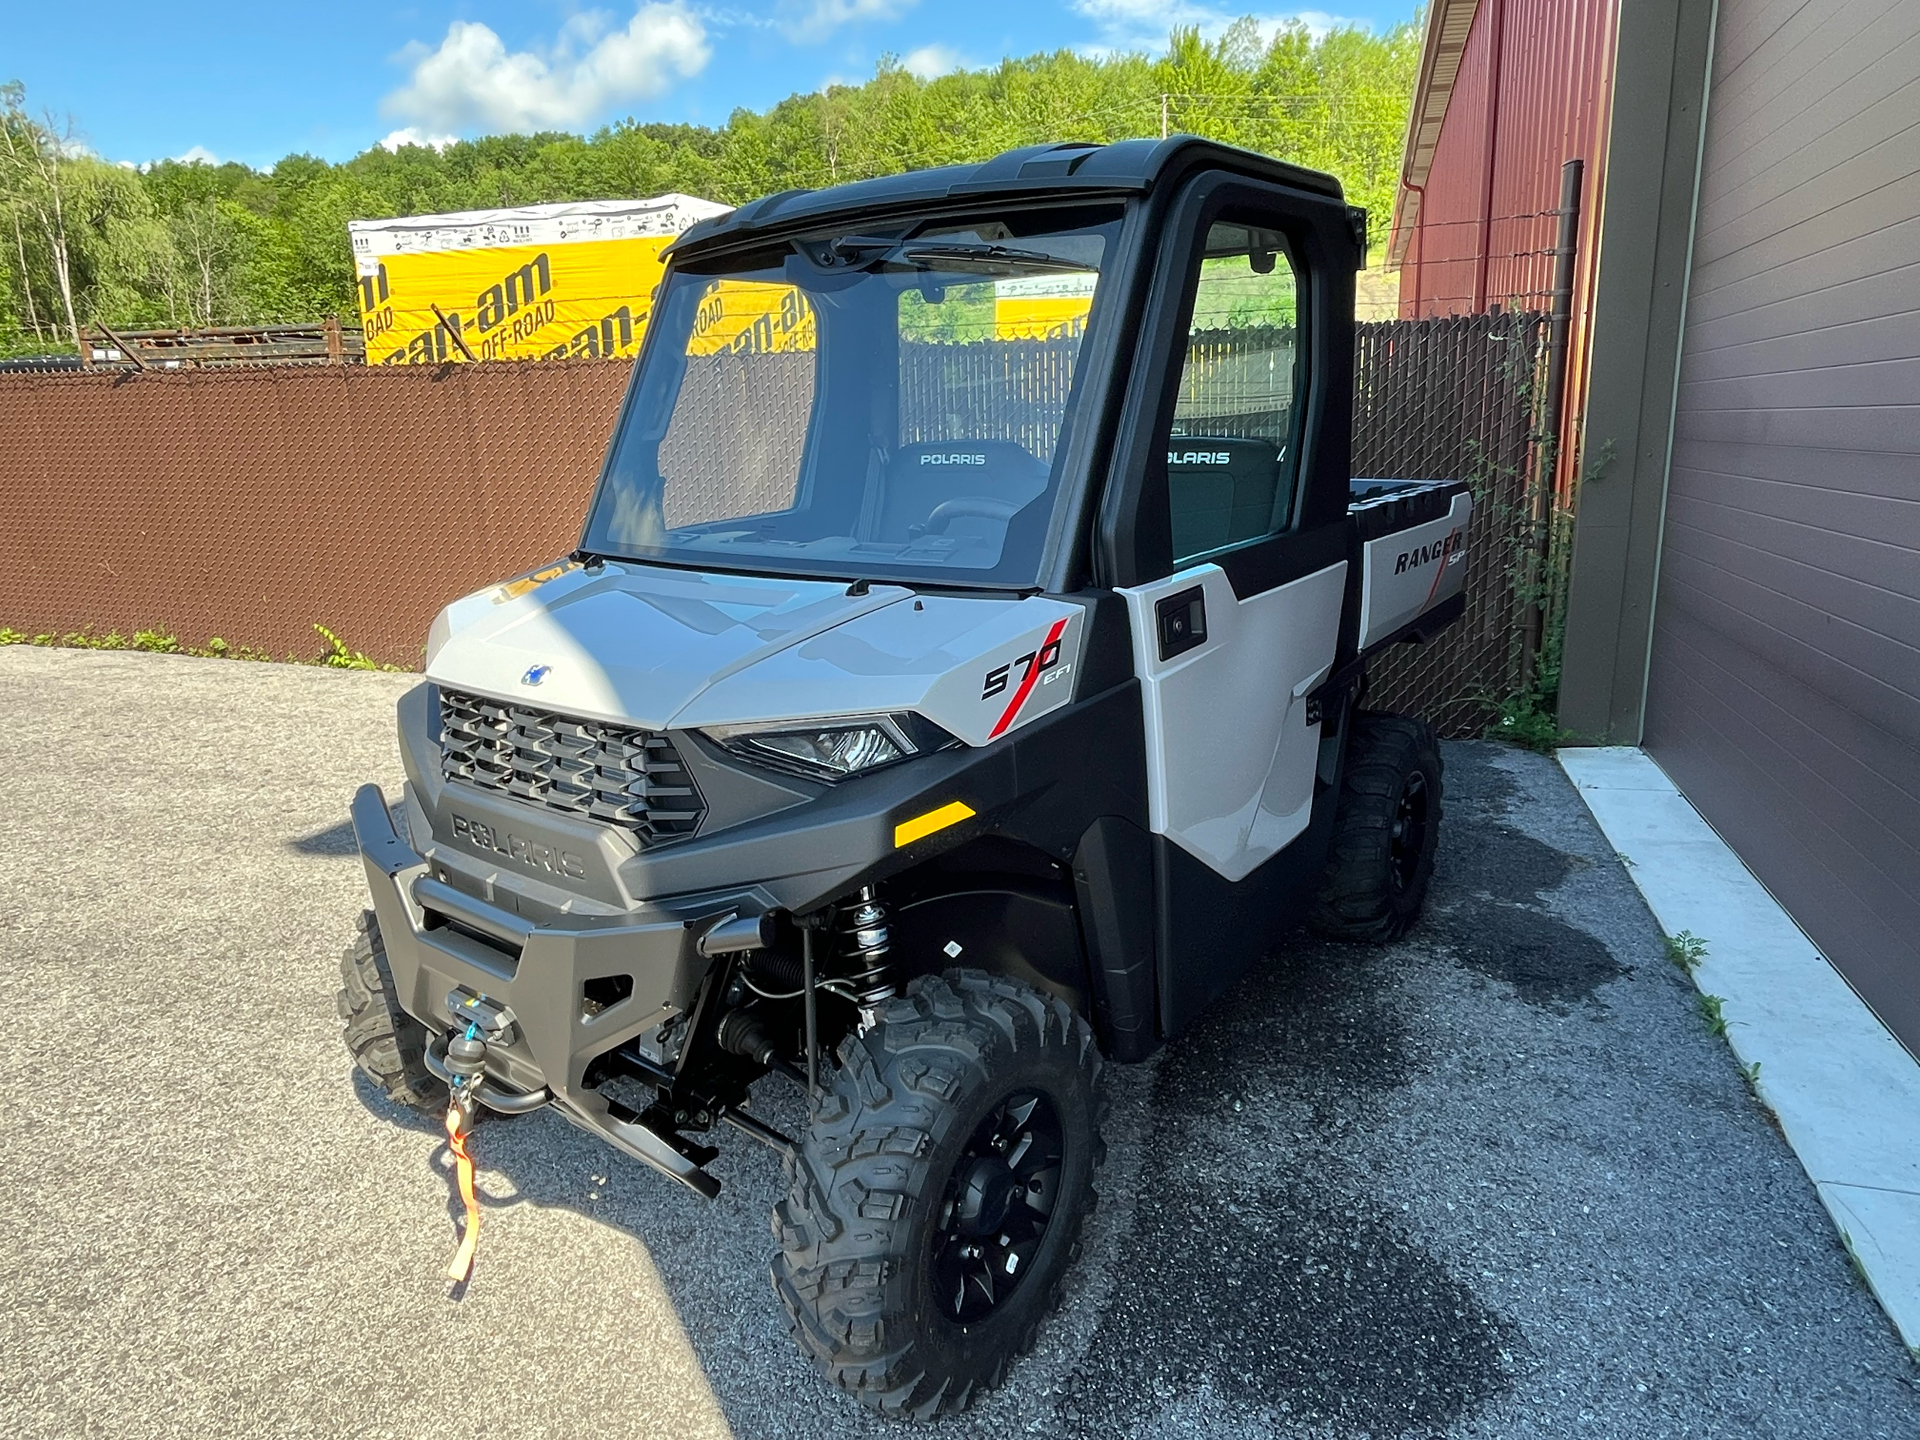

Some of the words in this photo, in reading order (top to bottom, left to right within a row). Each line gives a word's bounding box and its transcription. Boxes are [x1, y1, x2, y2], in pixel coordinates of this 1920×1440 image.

[481, 298, 555, 361] OFF-ROAD
[920, 453, 986, 465] POLARIS
[1393, 532, 1463, 576] RANGER
[1448, 549, 1466, 567] SP
[980, 638, 1062, 702] 570
[1043, 663, 1071, 686] EFI
[451, 813, 587, 880] POLARIS
